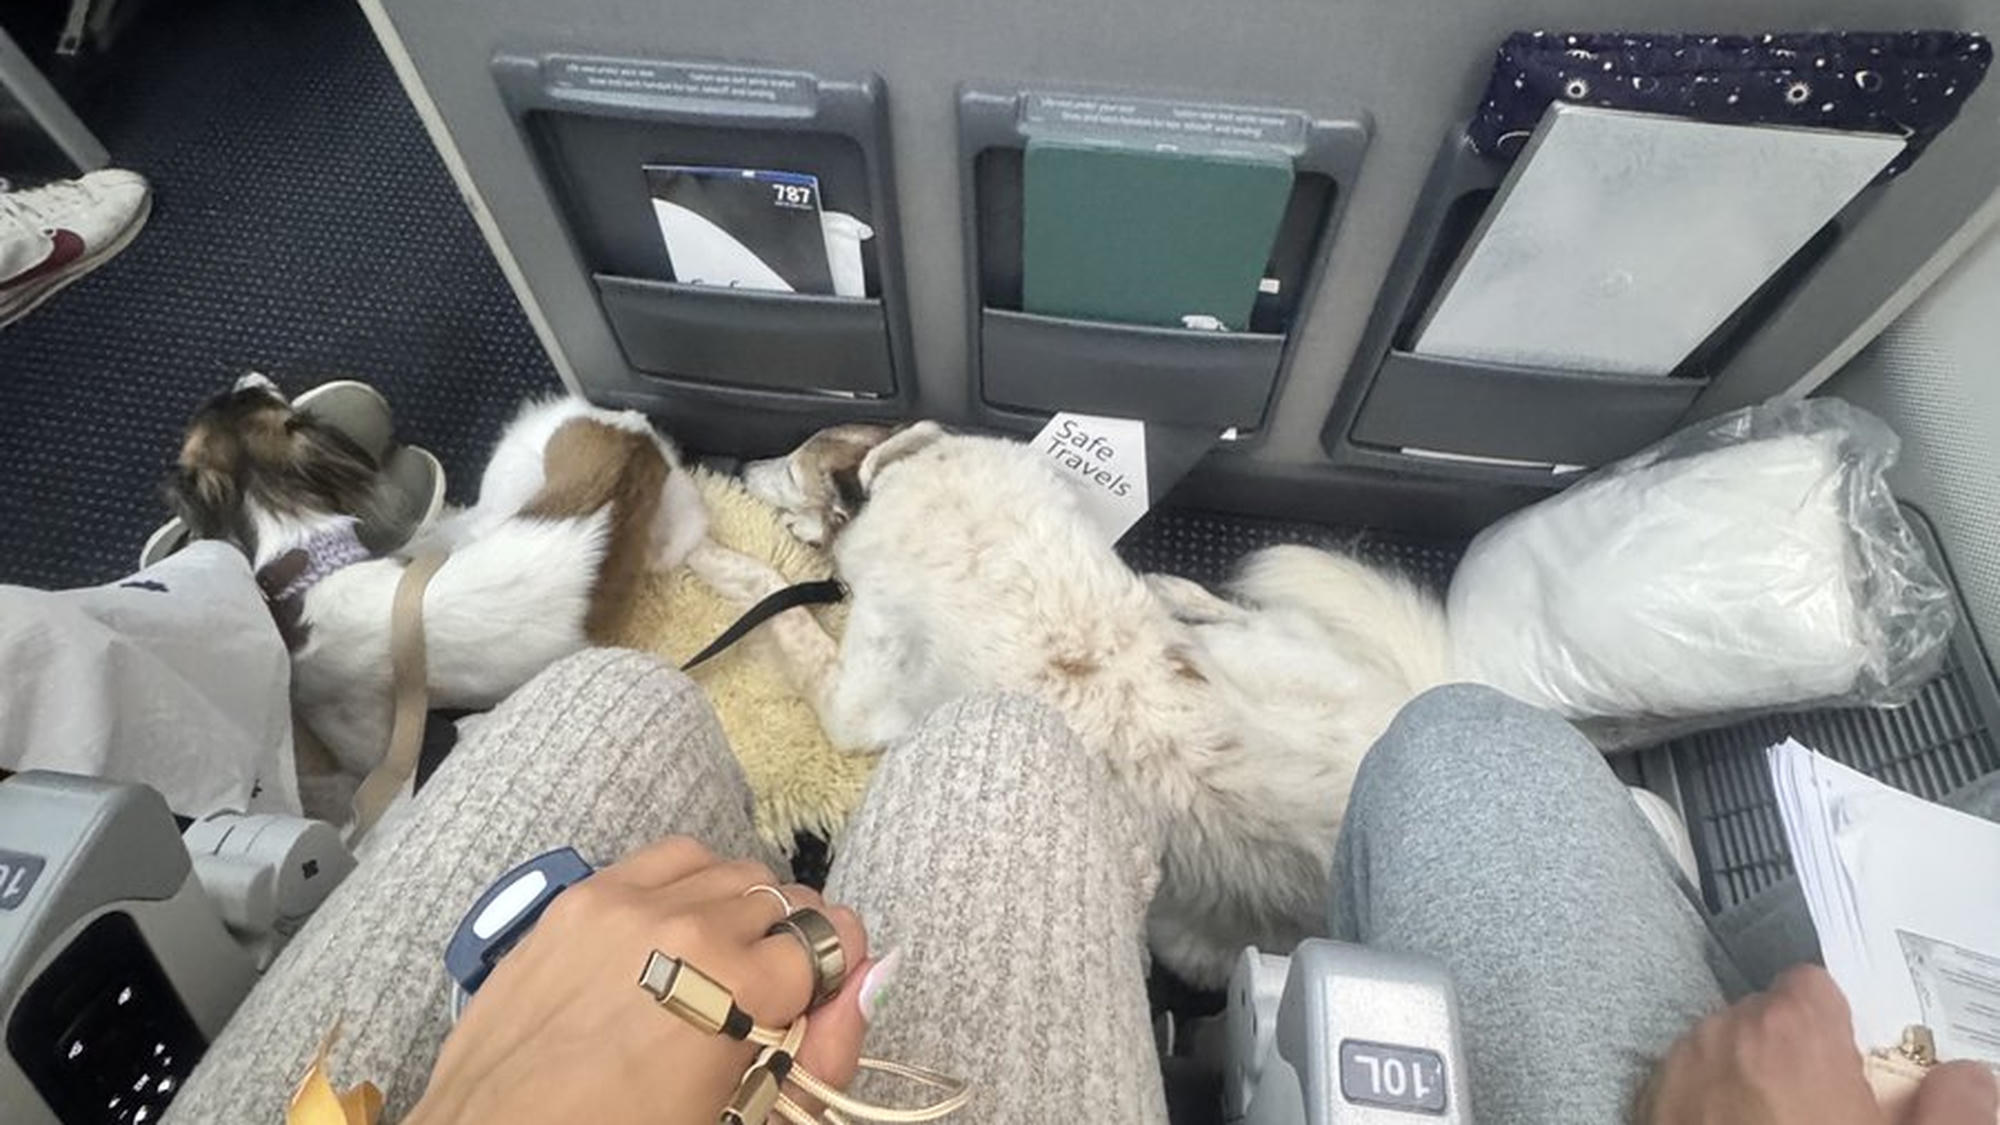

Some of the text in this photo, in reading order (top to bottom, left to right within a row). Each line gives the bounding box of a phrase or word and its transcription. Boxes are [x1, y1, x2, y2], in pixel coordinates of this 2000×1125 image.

[771, 183, 810, 204] 787
[1055, 420, 1115, 462] Safe
[1046, 436, 1132, 497] Travels
[1353, 1055, 1431, 1099] 10L
